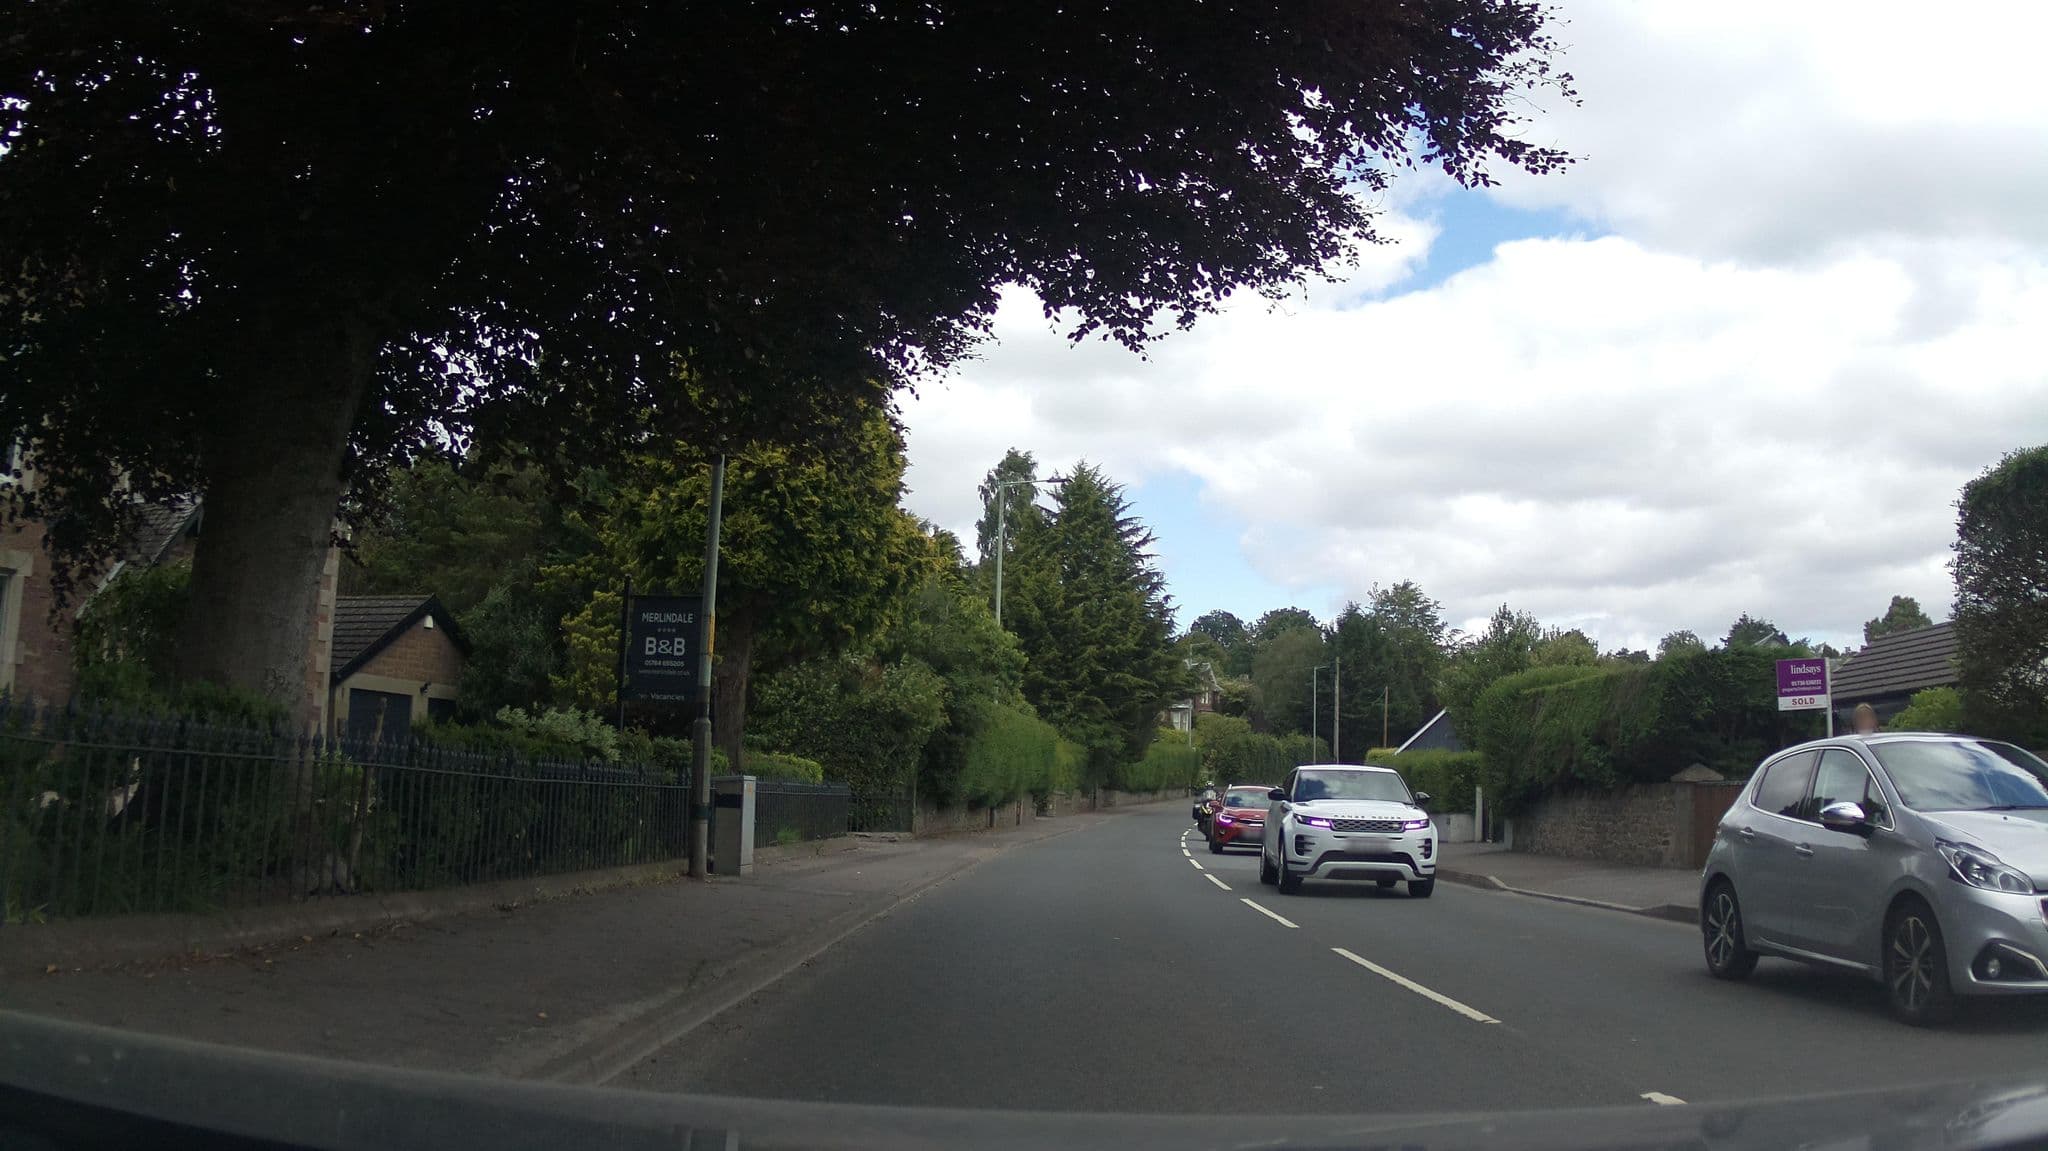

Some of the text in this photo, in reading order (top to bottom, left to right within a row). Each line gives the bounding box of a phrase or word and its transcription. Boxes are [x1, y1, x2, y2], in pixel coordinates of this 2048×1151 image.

[641, 612, 694, 624] MERLINDALE
[645, 636, 686, 656] B&B
[1792, 697, 1815, 706] SOLD
